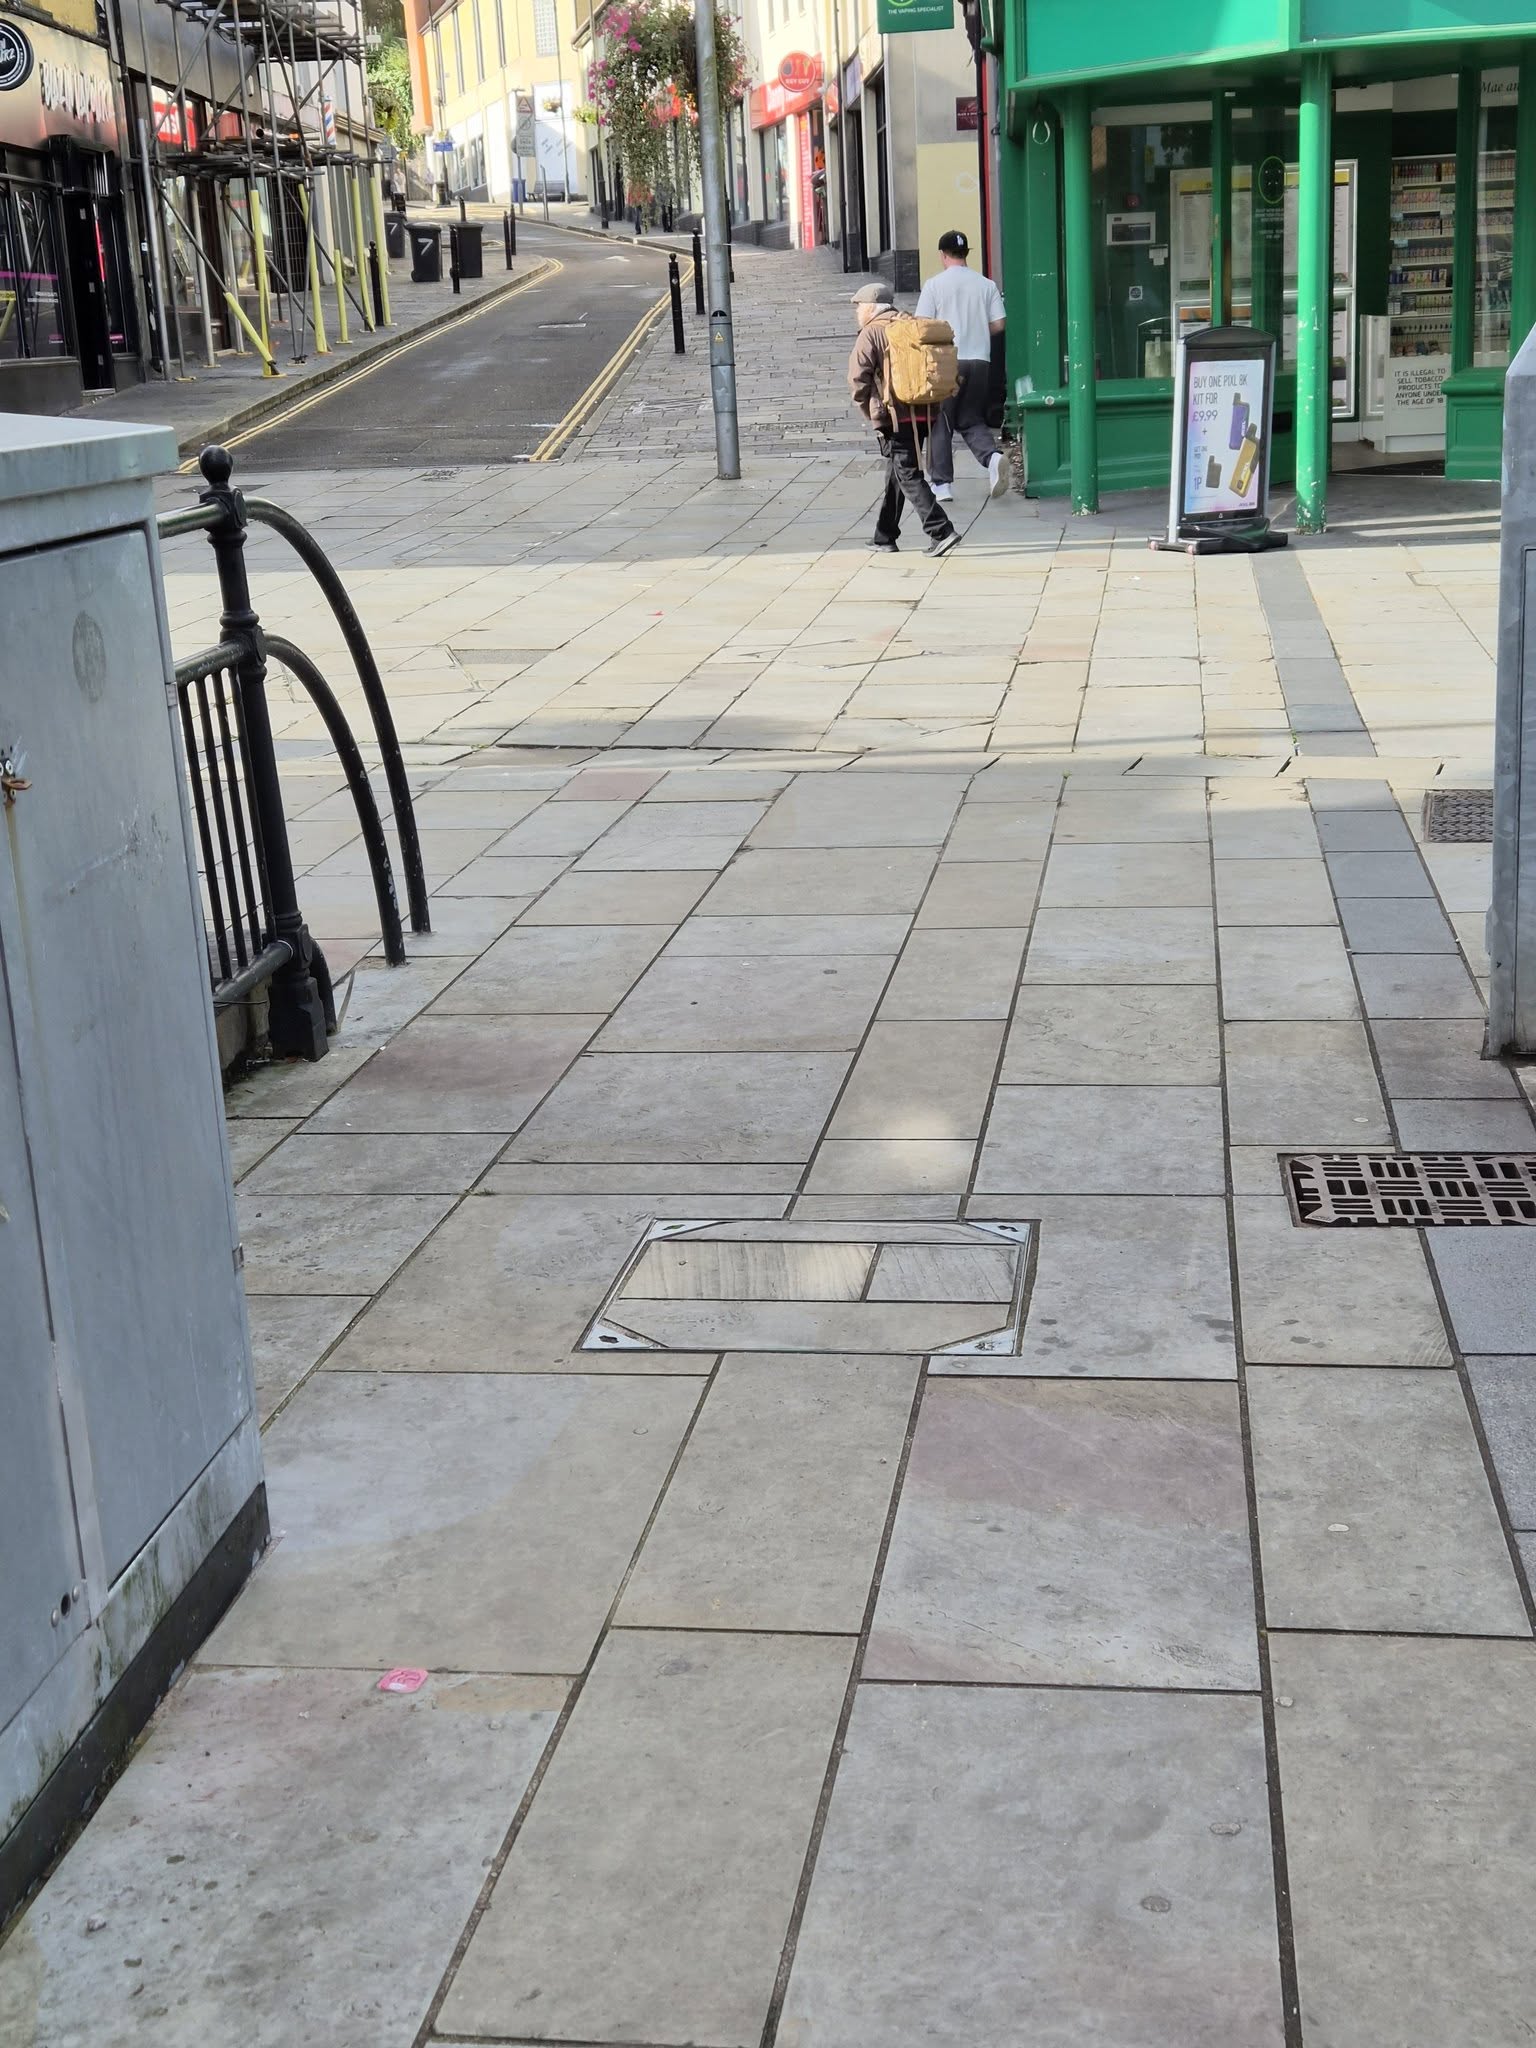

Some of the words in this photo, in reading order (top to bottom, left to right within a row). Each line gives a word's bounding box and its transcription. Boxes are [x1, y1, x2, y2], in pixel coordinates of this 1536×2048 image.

[418, 238, 433, 256] 7
[1194, 376, 1207, 389] BUY
[1208, 375, 1221, 388] ONE
[1398, 383, 1432, 391] PRODUCTS
[1193, 393, 1204, 406] KIT
[1205, 392, 1218, 405] FOR
[1395, 391, 1421, 399] ANYONE
[1193, 411, 1218, 422] £9.99
